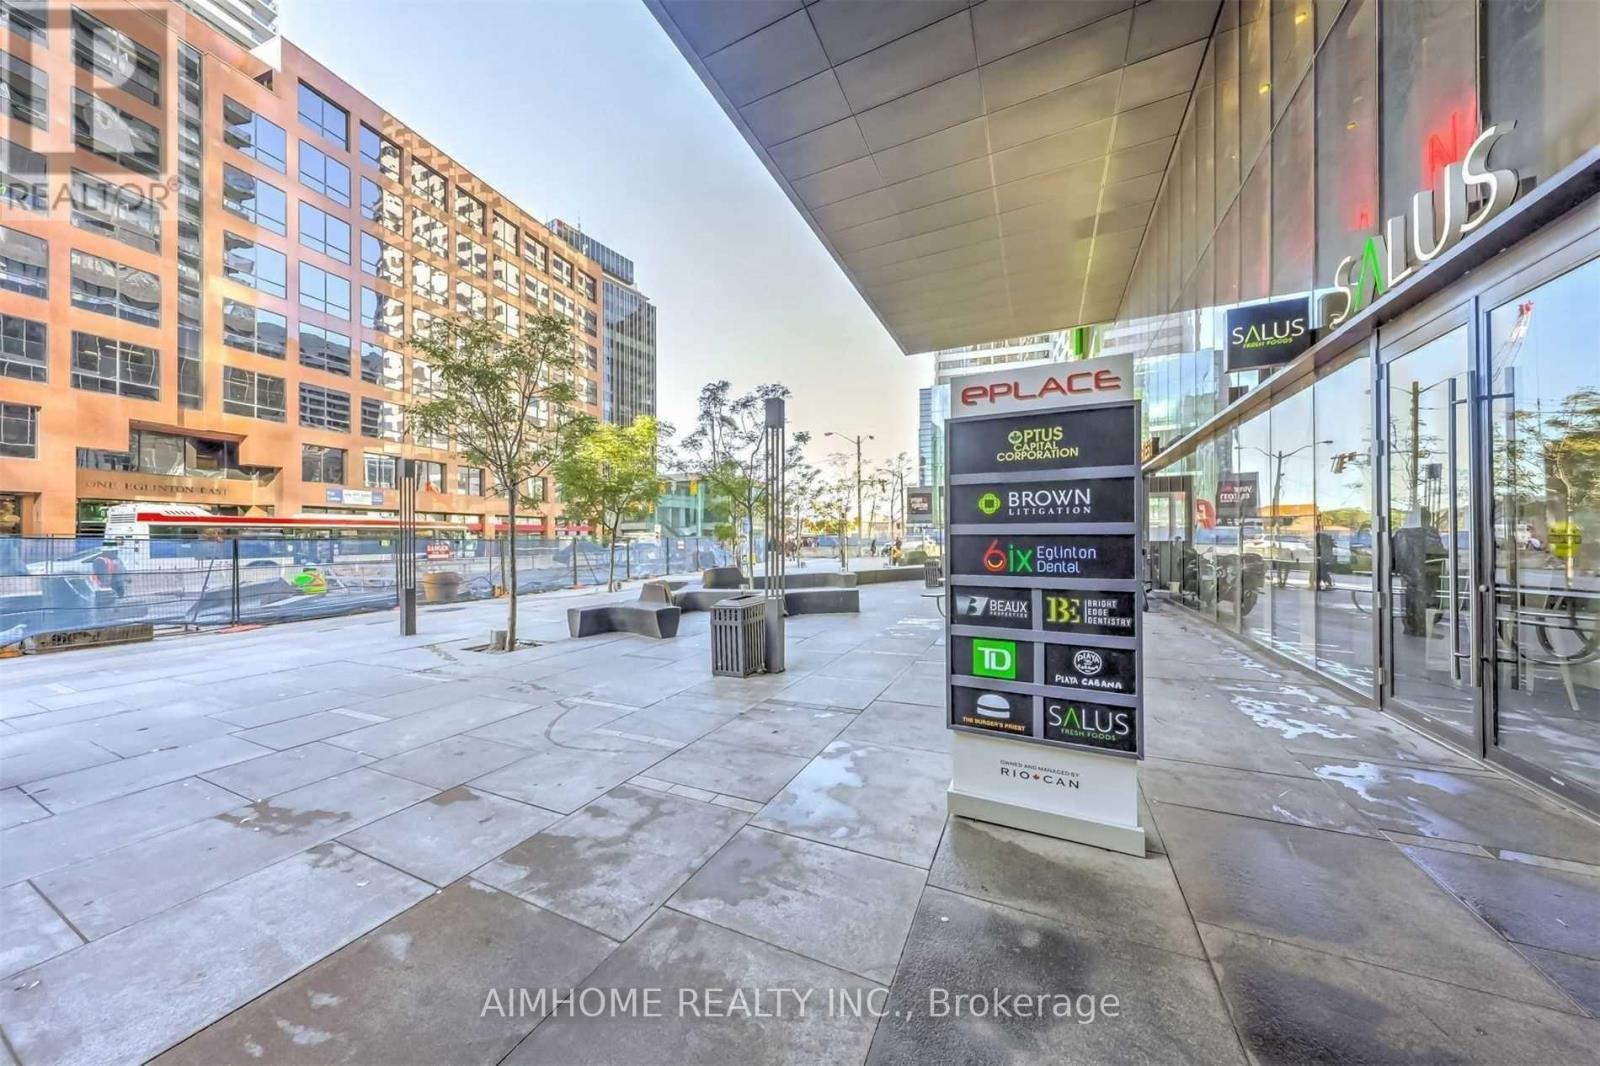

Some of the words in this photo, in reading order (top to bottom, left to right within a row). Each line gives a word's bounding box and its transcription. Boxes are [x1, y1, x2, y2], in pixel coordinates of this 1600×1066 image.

[1331, 119, 1521, 329] SALUS
[1232, 318, 1305, 345] SALUS
[1008, 426, 1063, 444] OPTUS
[996, 447, 1079, 461] CORPORATION
[1013, 441, 1059, 452] CAPITAL
[86, 480, 114, 489] ONE
[125, 482, 195, 494] EGLINTON
[200, 485, 228, 496] EAST
[1008, 488, 1090, 507] BROWN
[1008, 506, 1091, 516] LITIGATION
[1036, 545, 1097, 560] Eglinton
[1037, 560, 1080, 573] Dental
[990, 599, 1028, 613] BEAUX
[1087, 600, 1118, 608] BRIGHT
[1087, 616, 1131, 627] DENTISTRY
[977, 647, 1012, 670] TD
[1055, 674, 1078, 685] PLAYA
[1081, 678, 1122, 690] CABANA
[1004, 723, 1025, 732] PRIEST
[1049, 705, 1129, 735] SALUS
[1061, 728, 1085, 737] FRESH
[1087, 731, 1117, 741] FOODS
[1000, 759, 1022, 767] OWNED
[1038, 766, 1070, 776] MANAGED
